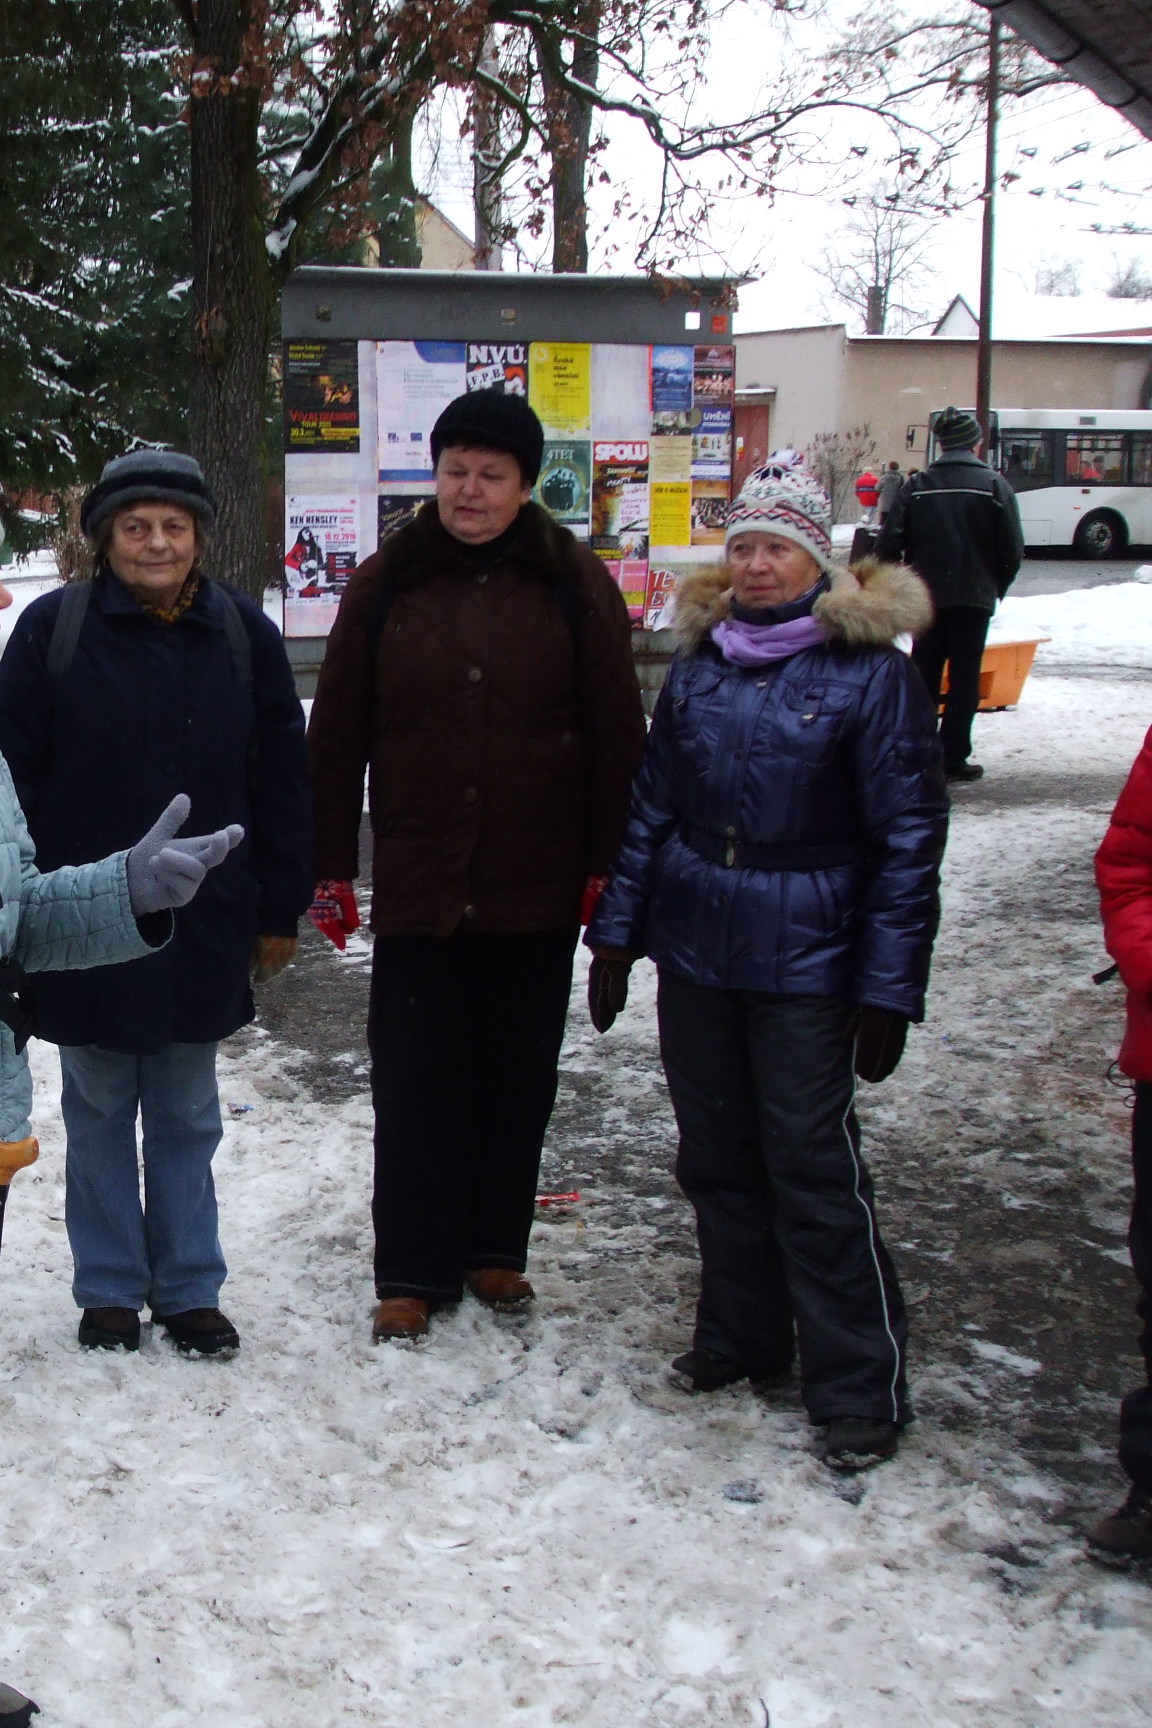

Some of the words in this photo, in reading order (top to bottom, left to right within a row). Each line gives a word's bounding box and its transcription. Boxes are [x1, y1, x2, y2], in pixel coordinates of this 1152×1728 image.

[468, 344, 528, 364] N.V.Ú.
[595, 443, 648, 461] SPOLU
[290, 515, 304, 525] KEN
[306, 515, 338, 525] HENSLEY
